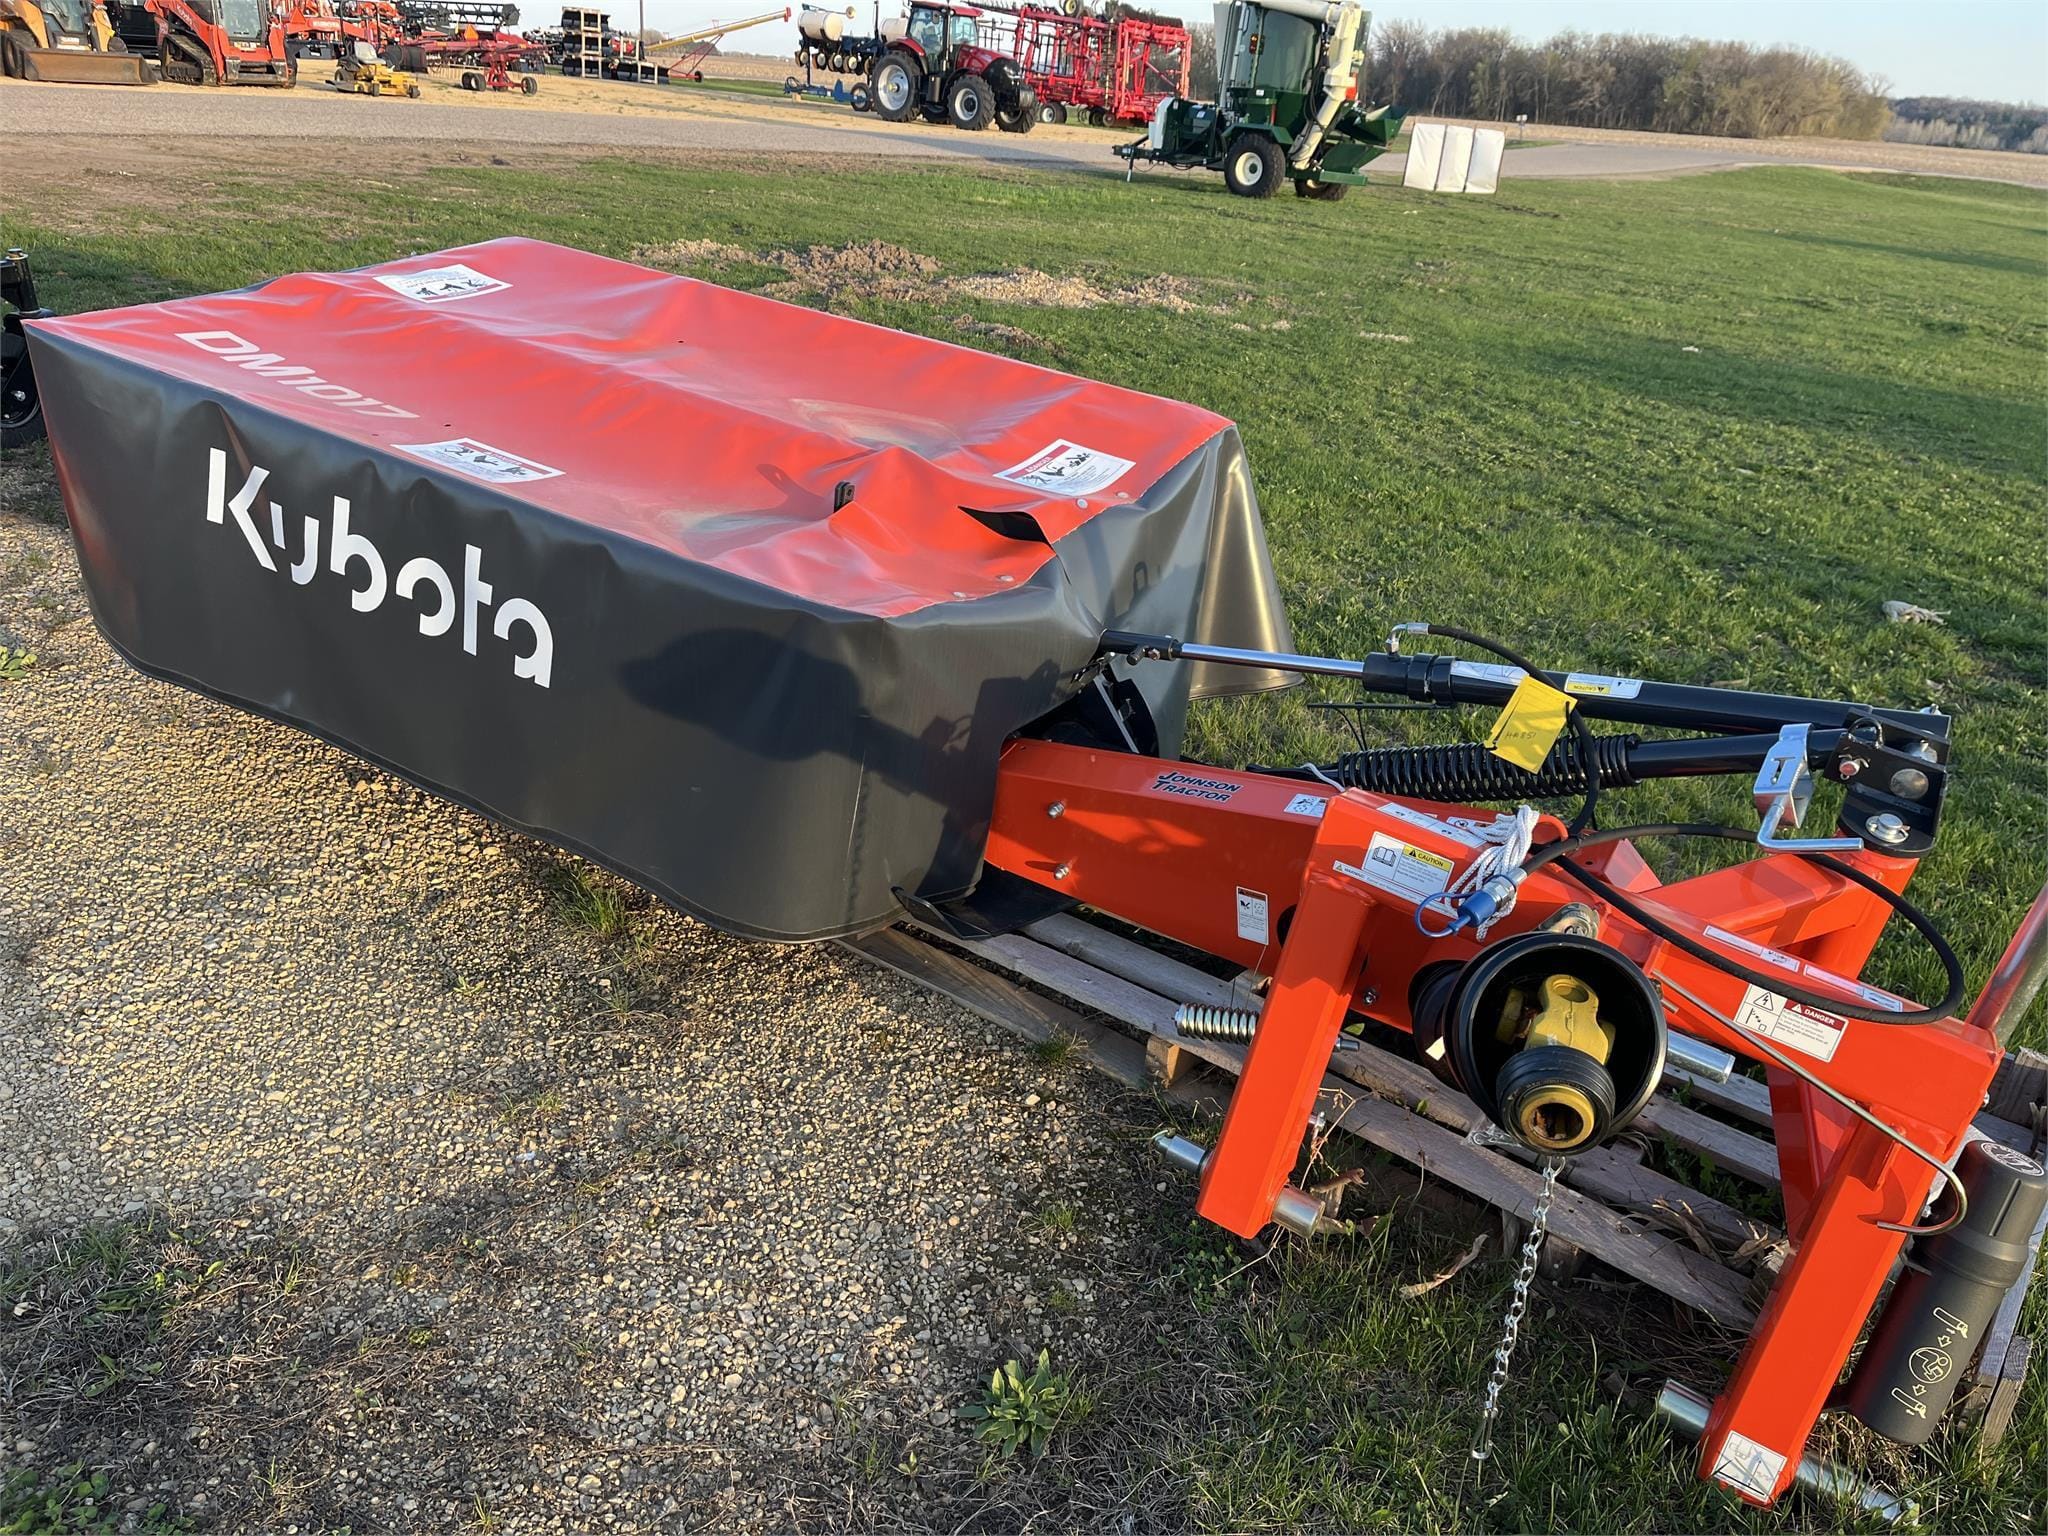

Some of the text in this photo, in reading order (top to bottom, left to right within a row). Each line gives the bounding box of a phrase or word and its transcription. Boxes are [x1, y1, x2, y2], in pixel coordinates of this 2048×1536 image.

[175, 330, 420, 419] DM1017
[206, 447, 554, 688] Kubota
[1152, 780, 1232, 802] TRACTOR
[1159, 771, 1241, 793] JOHNSON
[1417, 853, 1444, 867] CAUTION
[1804, 1008, 1835, 1025] DANGER
